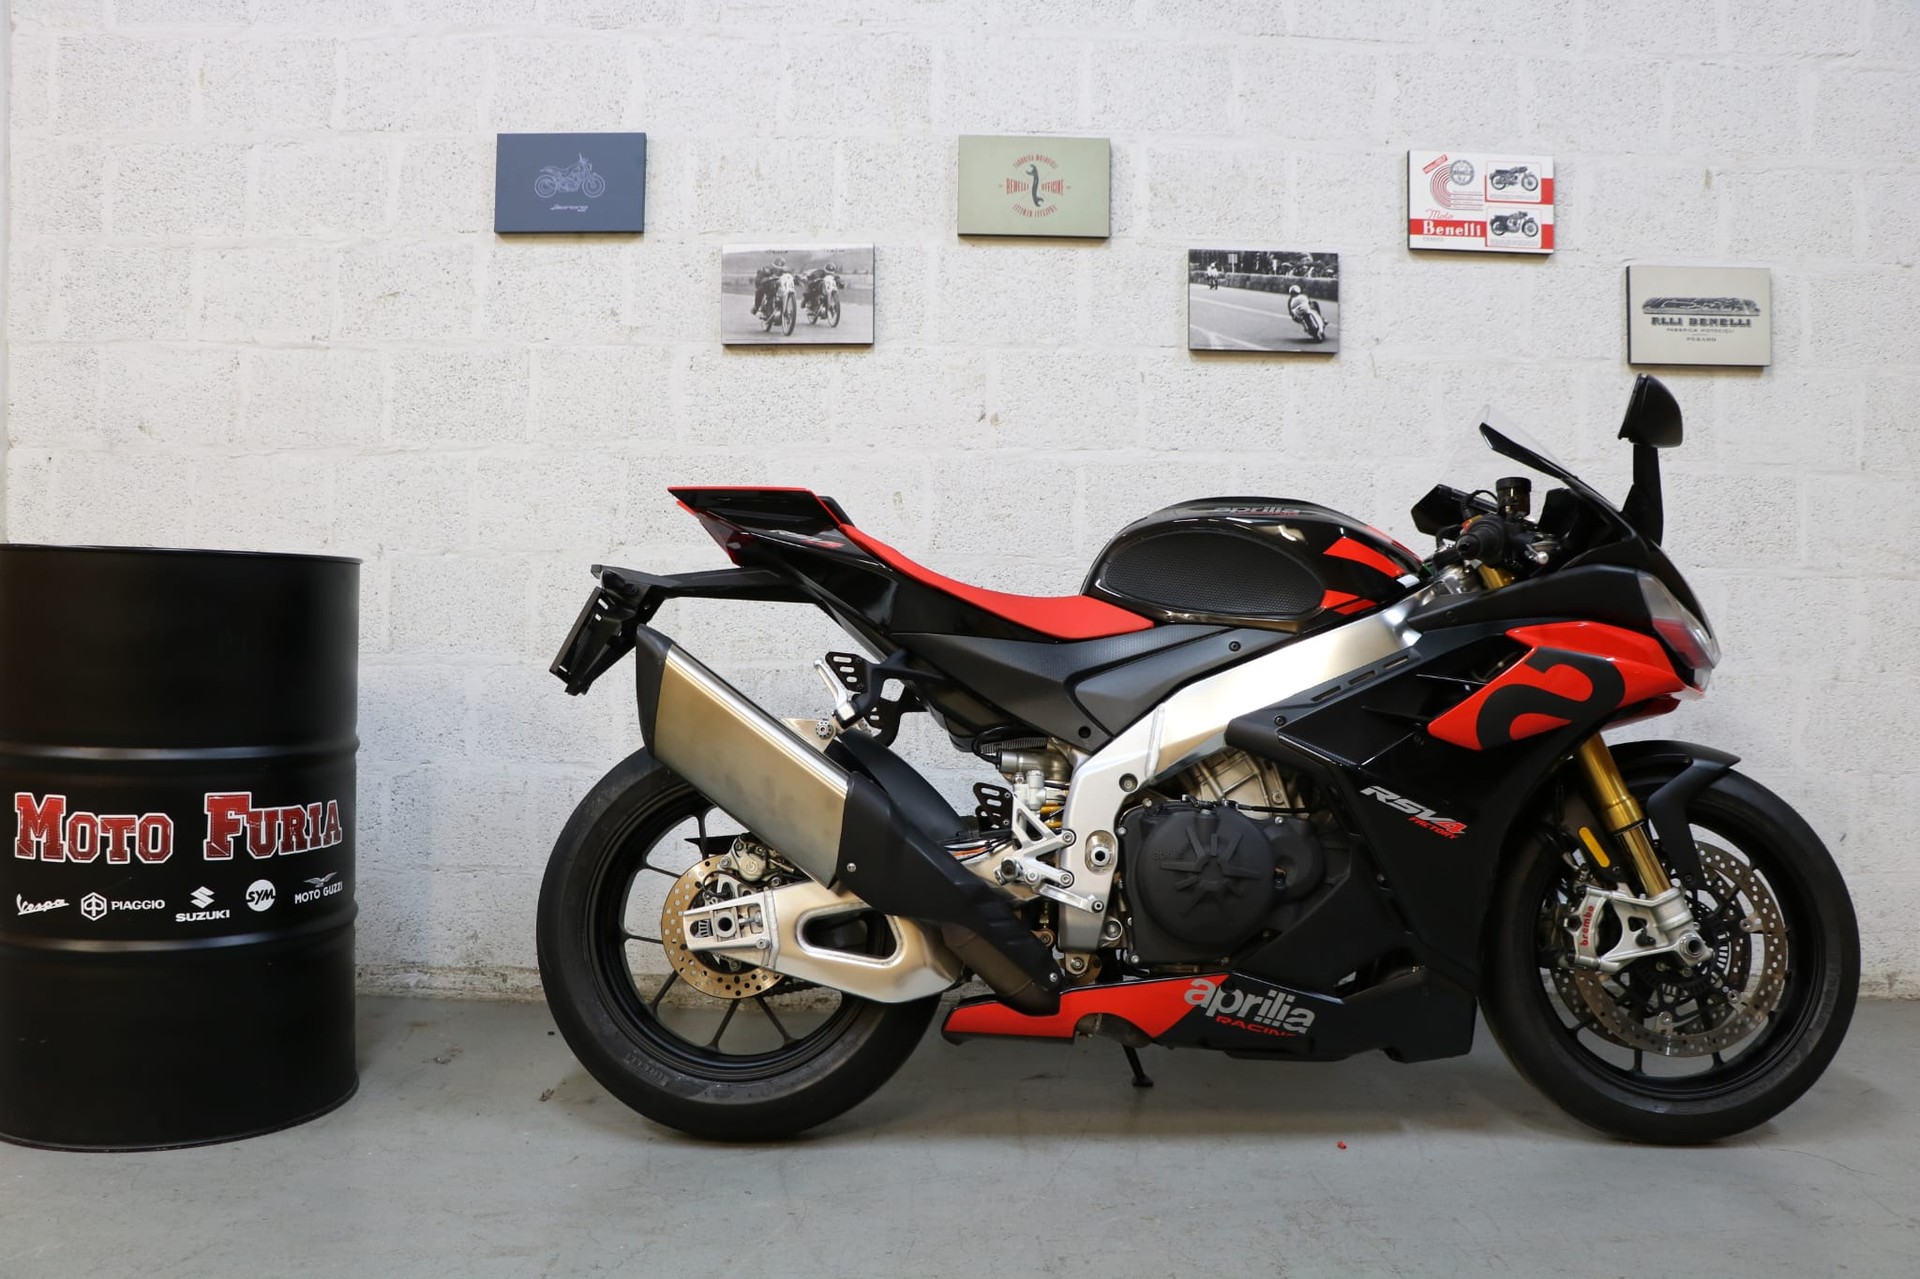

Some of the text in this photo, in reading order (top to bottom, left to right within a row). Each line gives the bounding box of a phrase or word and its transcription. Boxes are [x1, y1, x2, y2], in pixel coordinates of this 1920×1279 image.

[1423, 220, 1481, 236] Benelli
[1688, 317, 1752, 328] BENELLI
[1214, 506, 1300, 515] aprilia
[15, 791, 343, 864] MOTO FURIA
[246, 888, 276, 906] SYM
[294, 880, 343, 905] MOTO GUZZI
[16, 893, 70, 916] Vespa
[111, 899, 166, 911] PIAGGIO
[175, 909, 231, 923] SUZUKI
[1579, 904, 1595, 947] brembo
[1184, 978, 1316, 1034] aprilia
